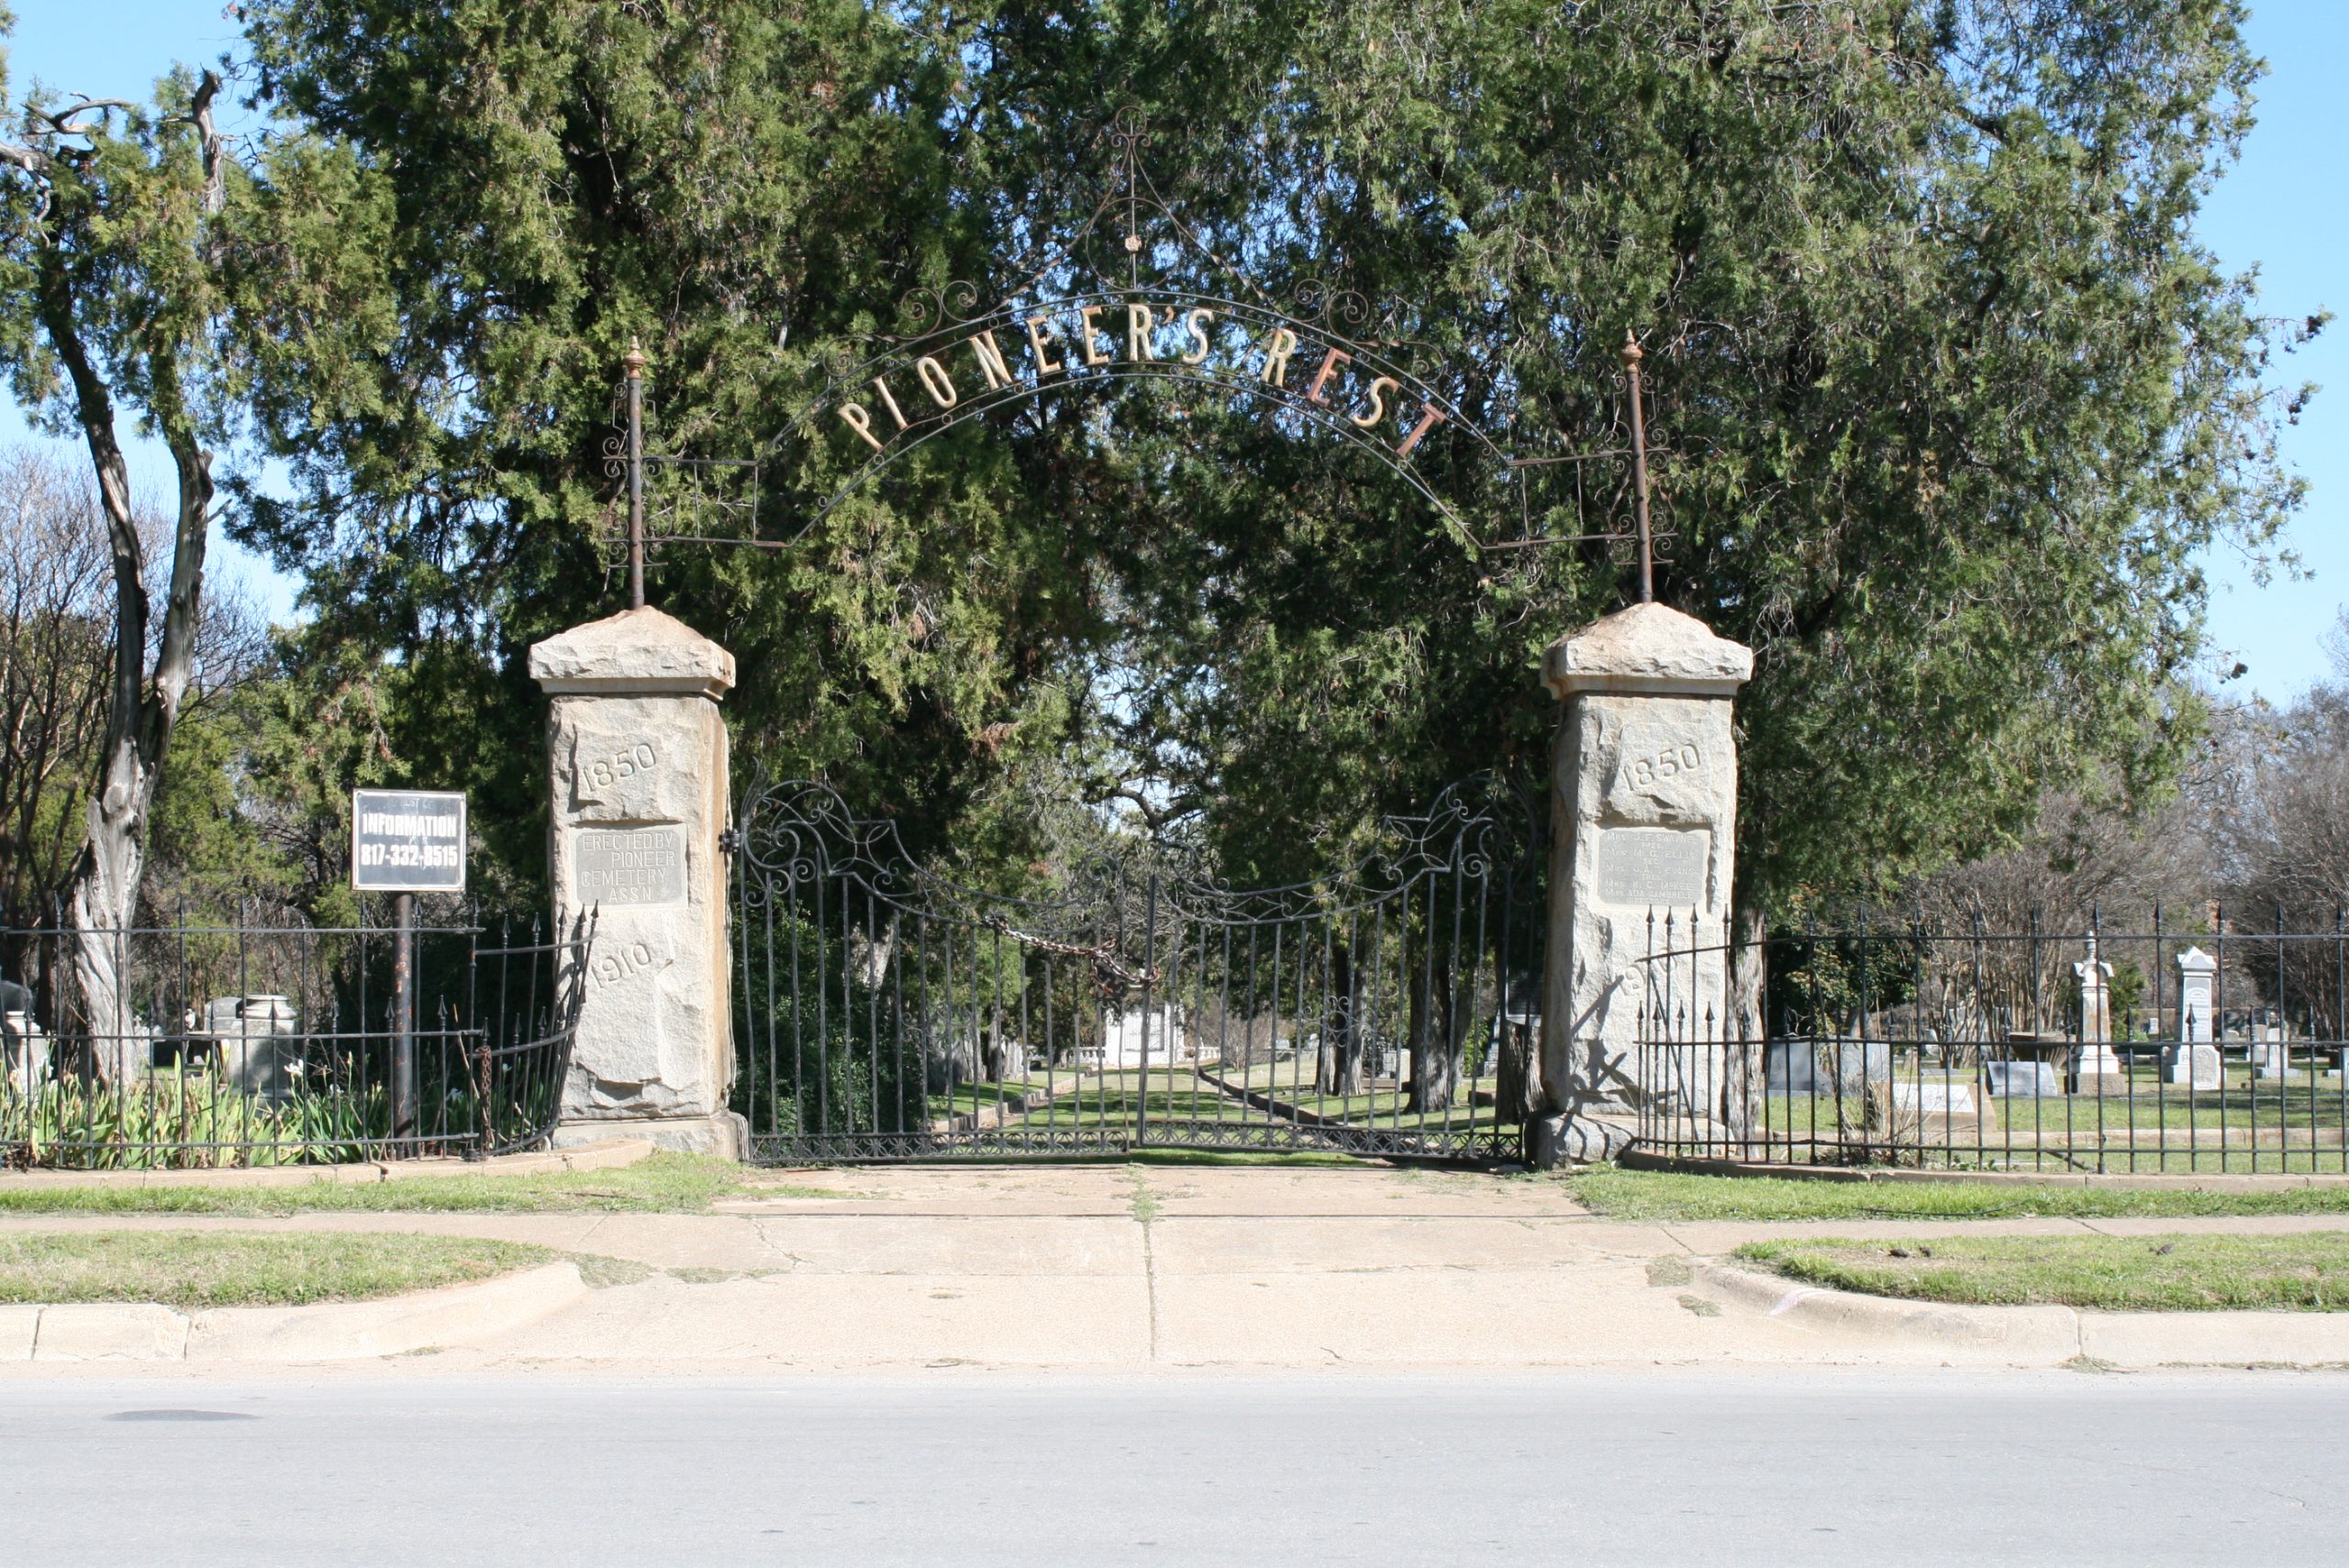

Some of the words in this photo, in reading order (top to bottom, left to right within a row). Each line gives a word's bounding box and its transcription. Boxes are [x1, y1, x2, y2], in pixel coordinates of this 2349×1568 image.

[838, 304, 1215, 452] PIONEER'S
[1262, 327, 1446, 458] REST
[582, 741, 657, 794] 1850
[1621, 743, 1700, 792] 1850
[362, 813, 456, 837] INFORMATION
[583, 832, 652, 851] ERECTED
[654, 832, 674, 849] BY
[361, 842, 459, 867] 817-332-8515
[611, 851, 676, 868] PIONEER
[581, 868, 666, 887] CEMETERY
[590, 942, 652, 991] 1910
